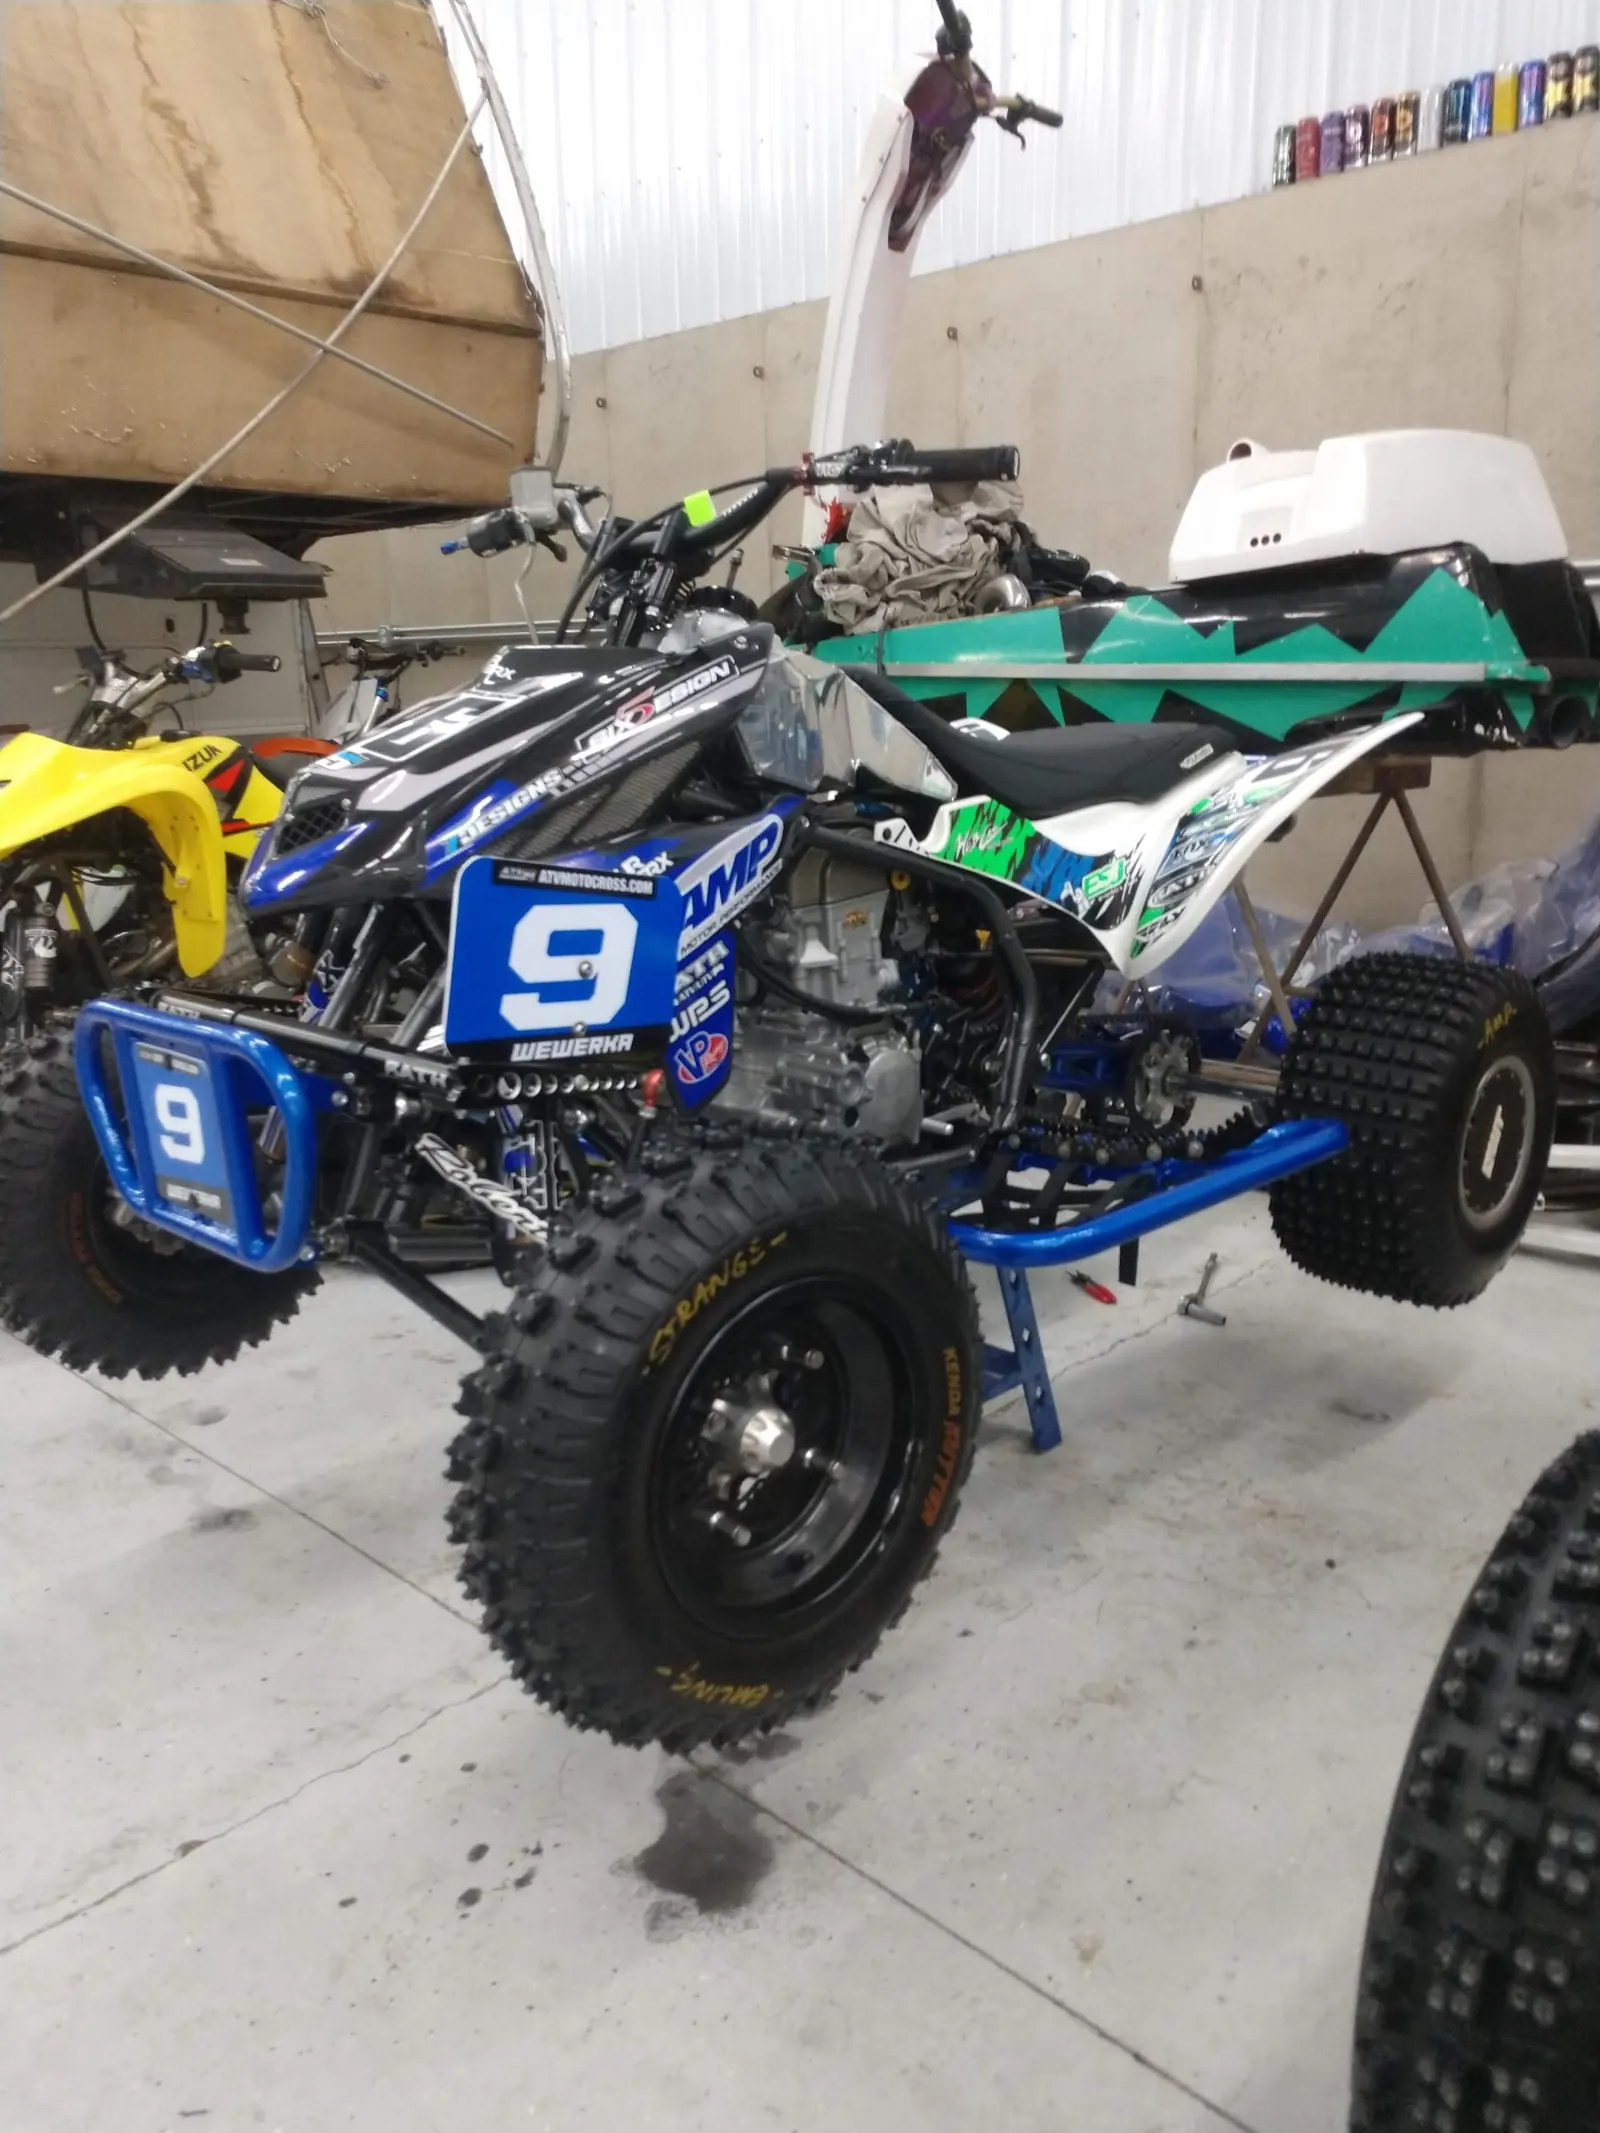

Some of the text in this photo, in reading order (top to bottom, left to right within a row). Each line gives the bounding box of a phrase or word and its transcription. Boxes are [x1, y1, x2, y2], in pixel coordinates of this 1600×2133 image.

[537, 869, 654, 896] ATVMOTOCROSS.COM
[684, 820, 781, 928] AMP
[680, 919, 718, 955] MOTOR
[499, 903, 639, 1031] 9
[675, 940, 729, 992] ATH
[511, 1032, 635, 1062] WEWERKA
[384, 1059, 448, 1088] RATH
[155, 1084, 205, 1164] 9
[943, 1345, 963, 1416] KENDA
